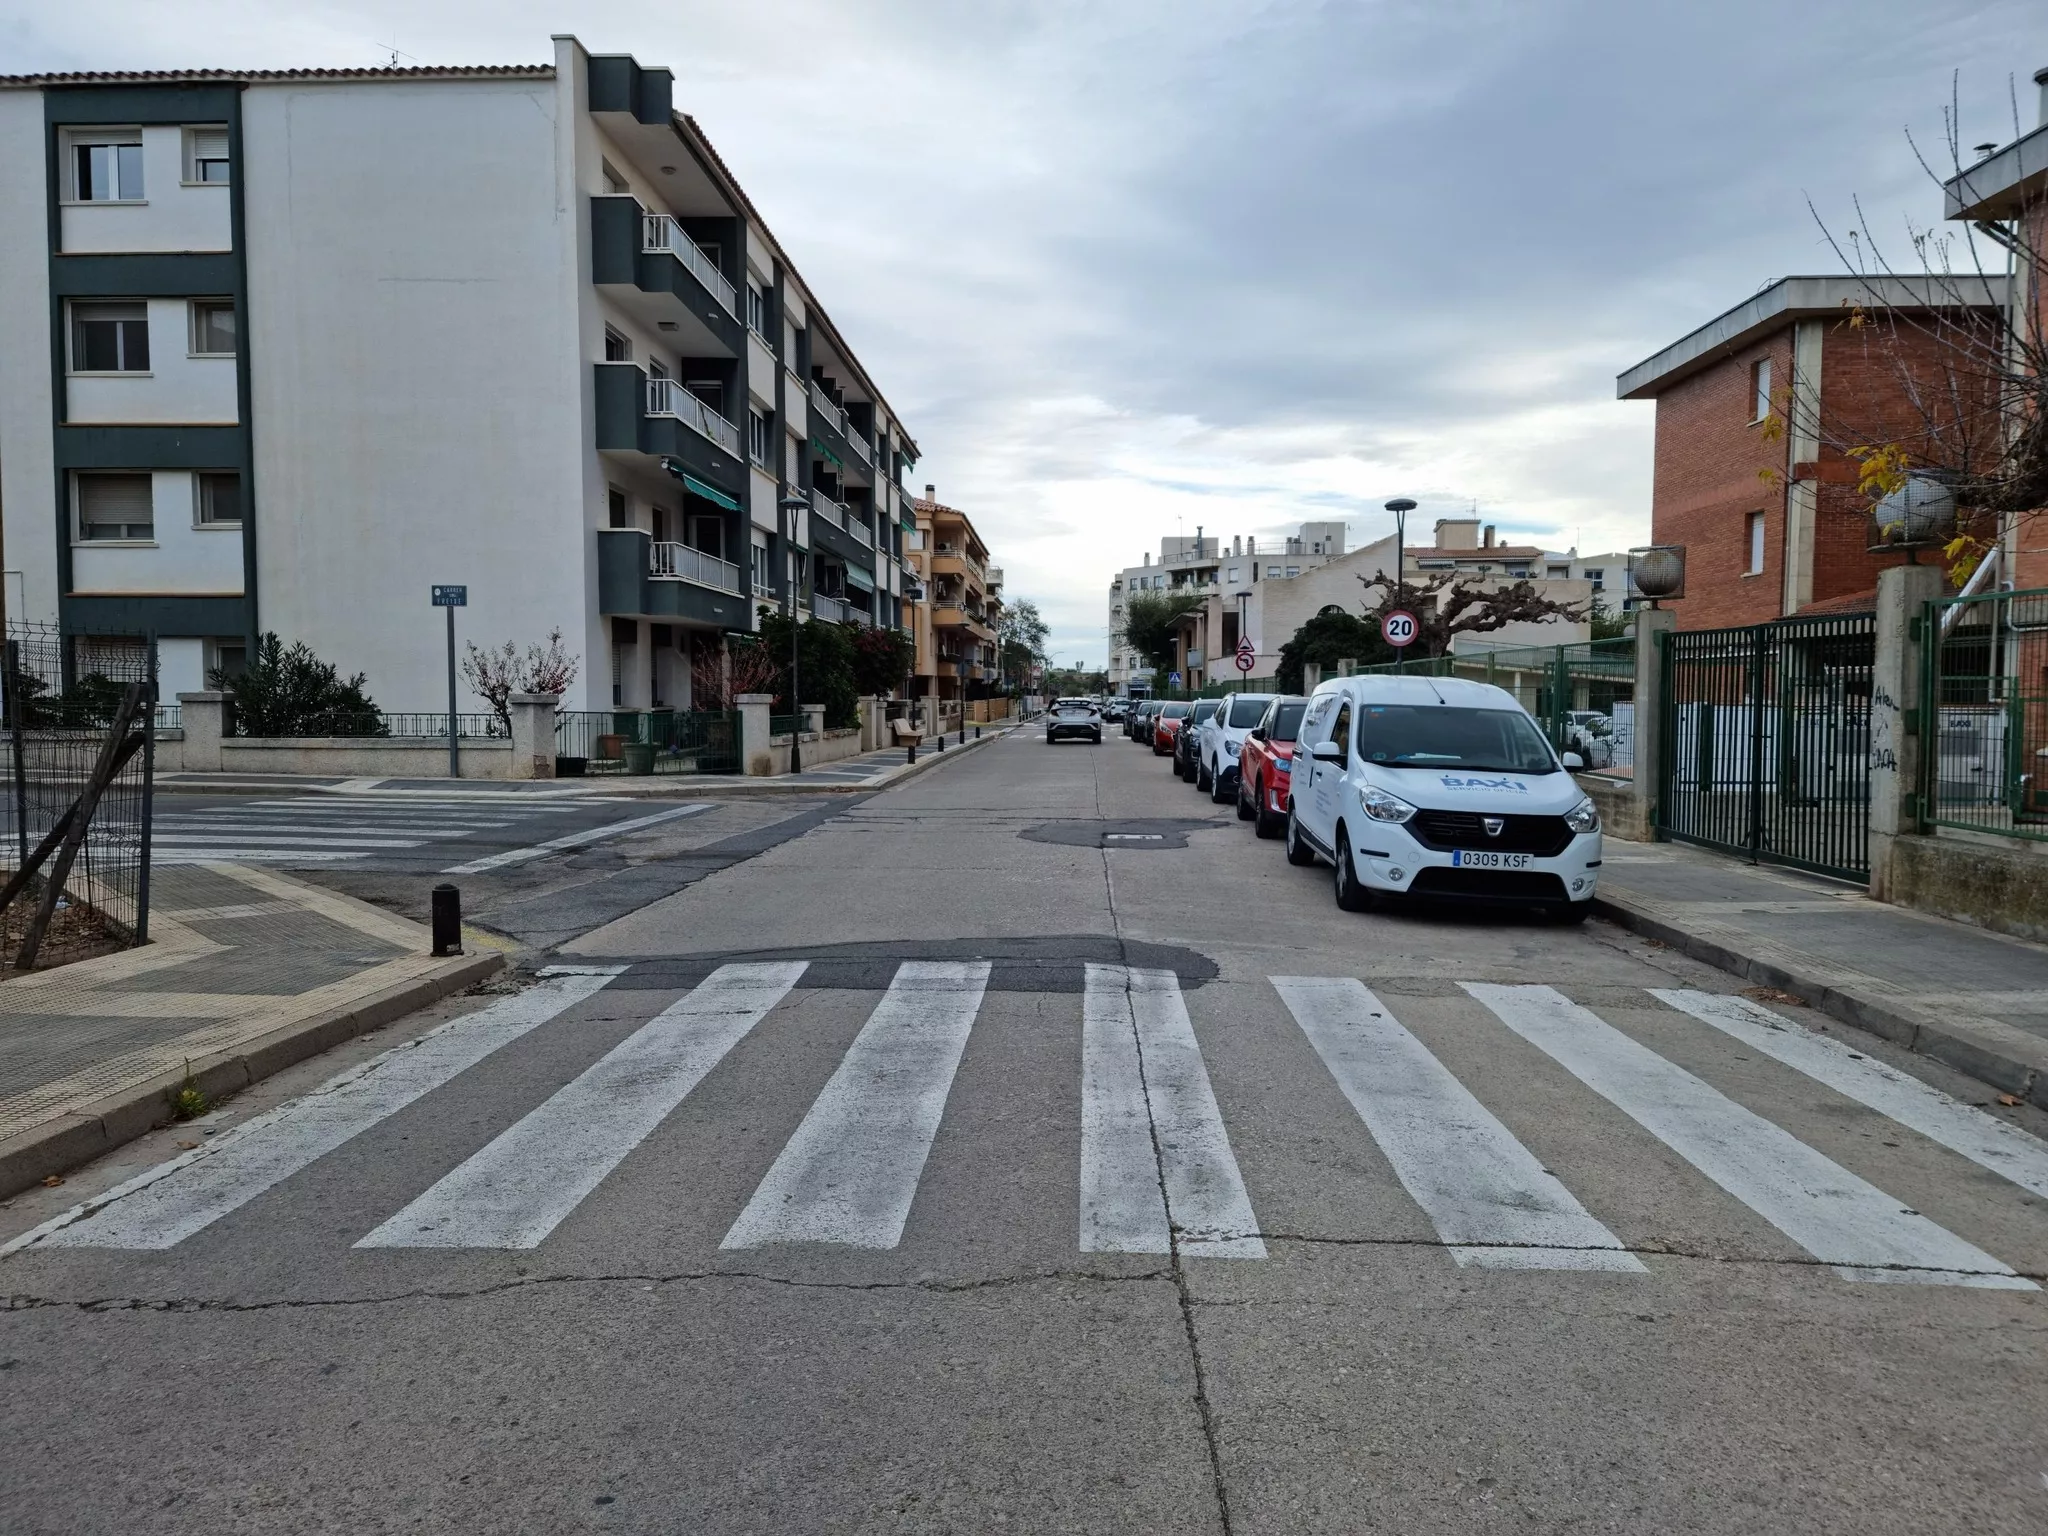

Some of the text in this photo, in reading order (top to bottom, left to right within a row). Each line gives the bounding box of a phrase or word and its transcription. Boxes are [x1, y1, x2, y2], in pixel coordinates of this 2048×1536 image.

[1389, 620, 1412, 636] 20
[1440, 778, 1528, 791] BAXI
[1463, 852, 1530, 868] 0309 KSF
